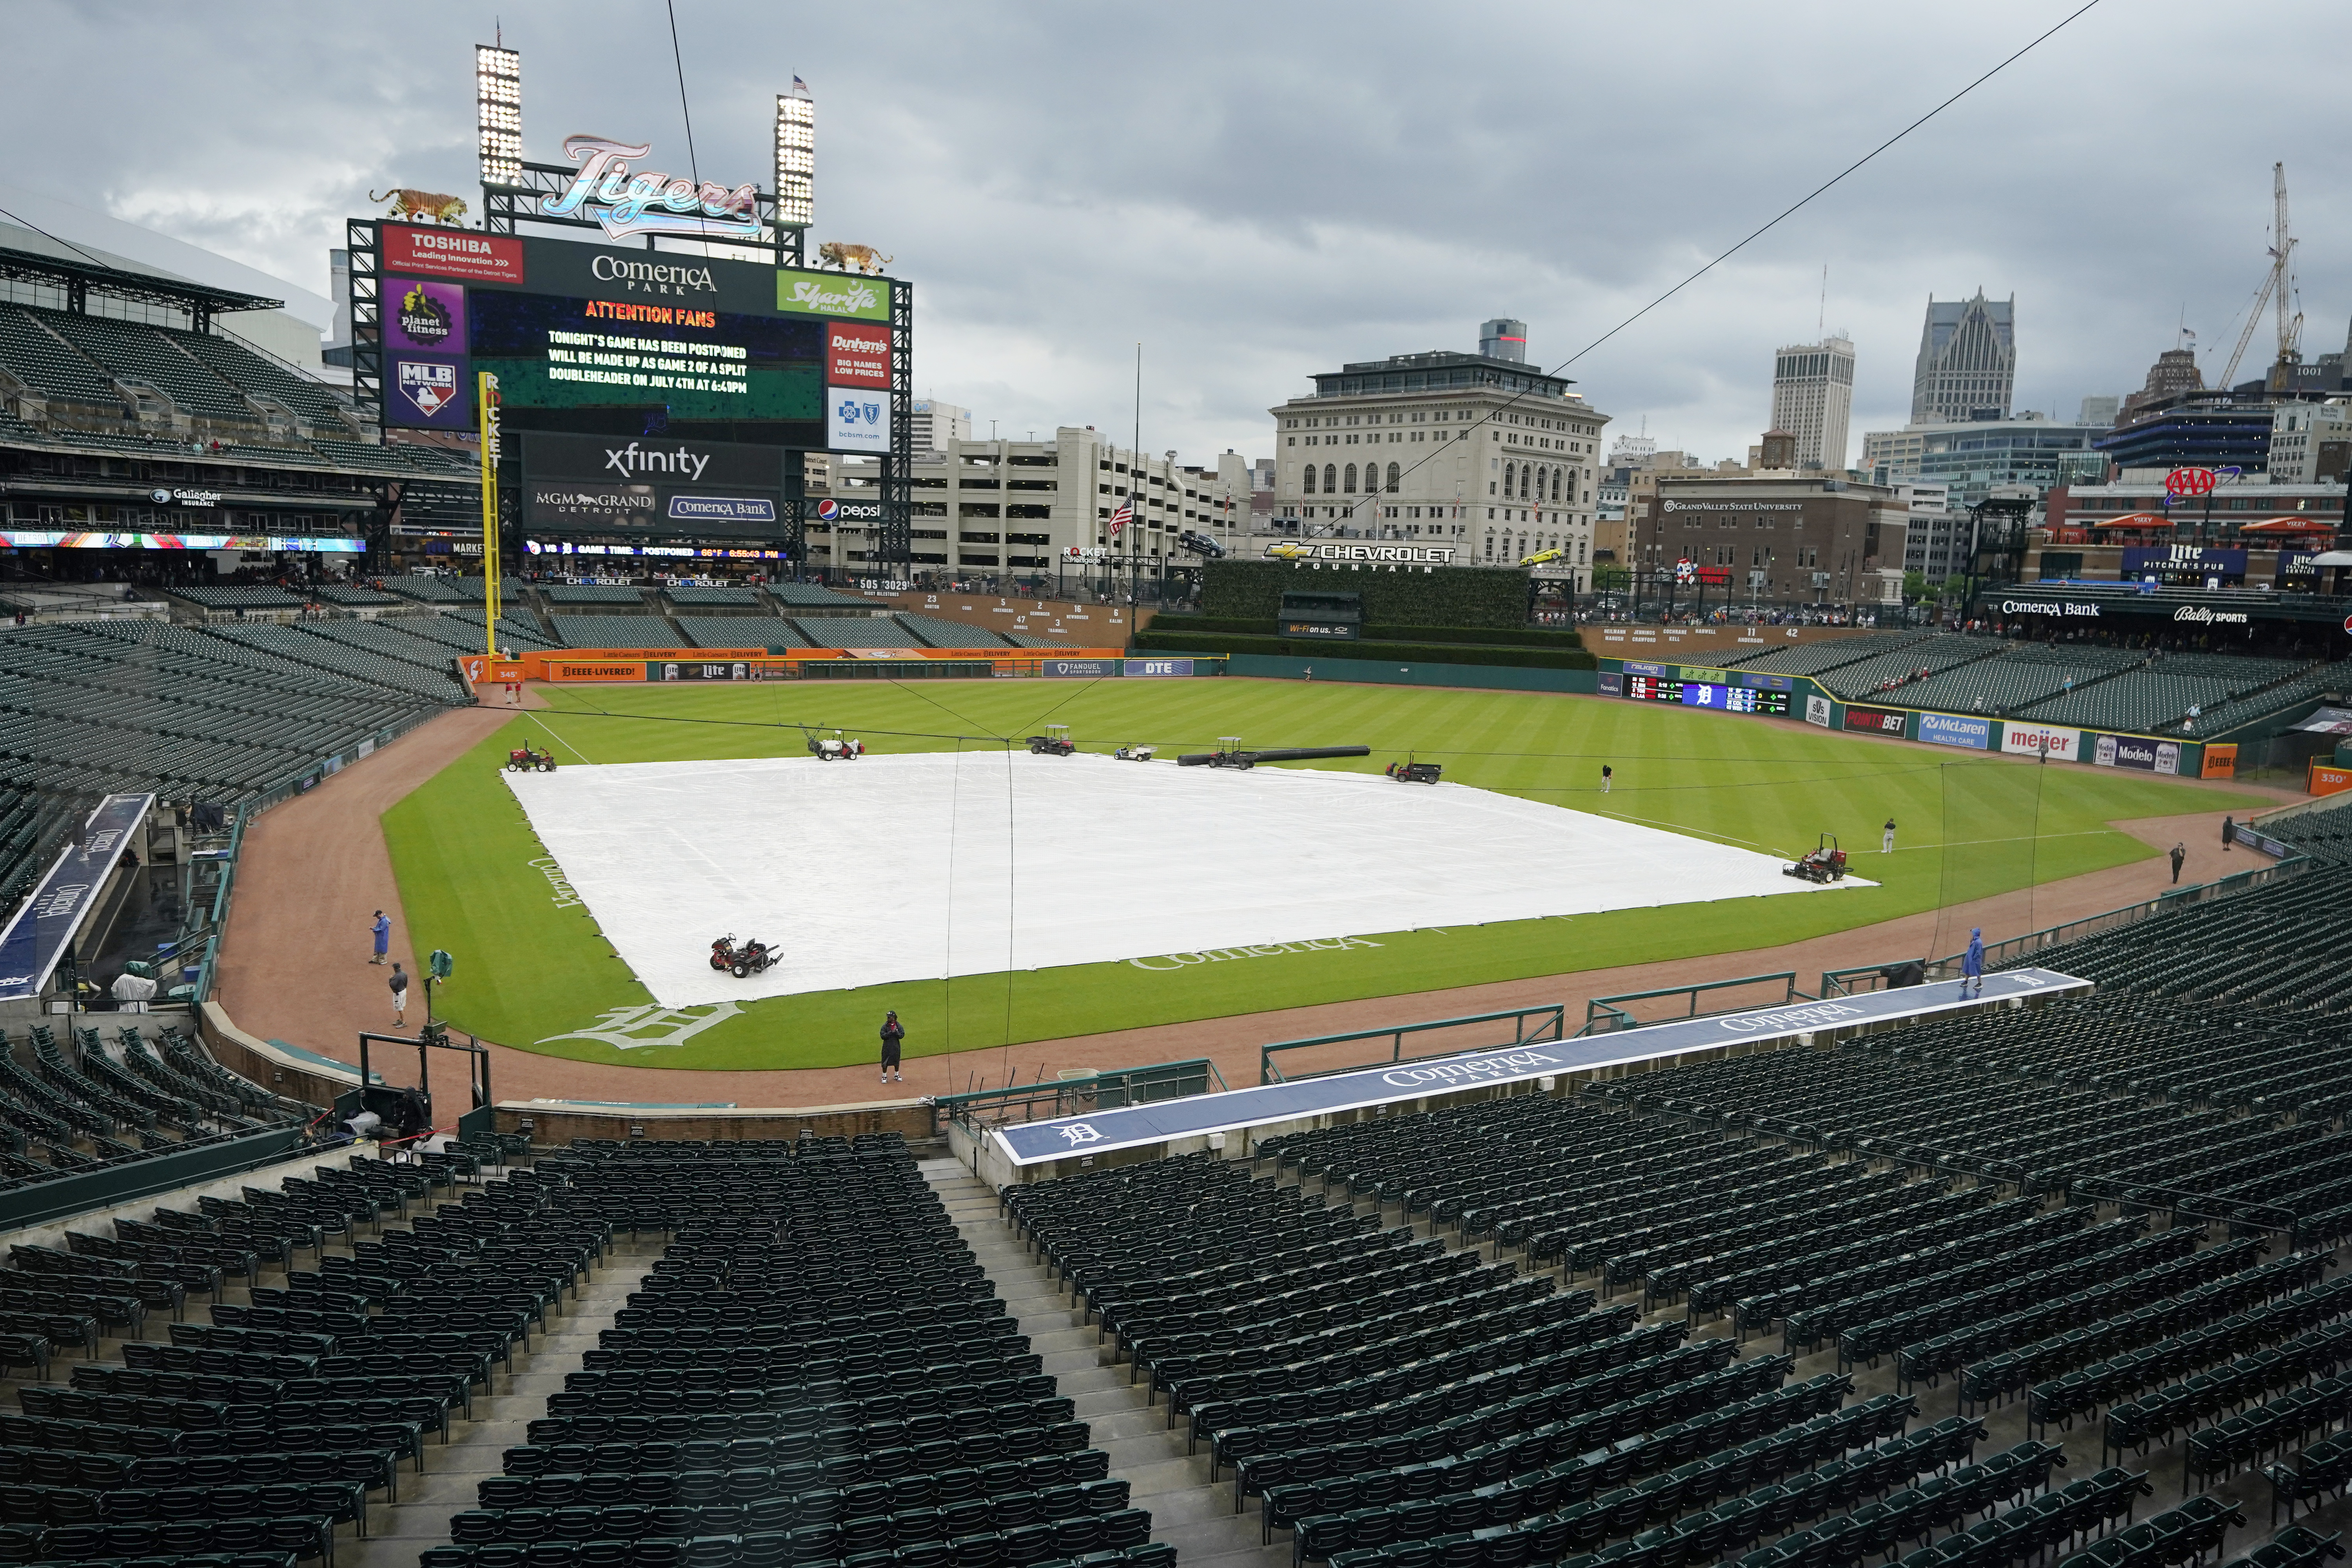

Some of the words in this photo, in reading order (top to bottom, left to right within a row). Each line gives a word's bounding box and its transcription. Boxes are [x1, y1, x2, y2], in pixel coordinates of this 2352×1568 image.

[540, 134, 762, 243] Tigers
[412, 234, 492, 254] TOSHIBA
[412, 250, 446, 261] Leading
[448, 254, 492, 265] Innovation
[627, 281, 685, 296] PARK
[585, 300, 672, 324] ATTENTION
[676, 309, 715, 328] FANS
[820, 305, 848, 313] HALAL
[402, 315, 439, 327] planet
[407, 324, 448, 336] fitness
[548, 330, 605, 347] TONIGHT'S
[607, 336, 636, 350] GAME
[638, 339, 659, 352] HAS
[661, 341, 686, 354] BEEN
[689, 343, 746, 359] POSTPONED
[832, 336, 887, 352] Dunham's
[549, 349, 577, 363] WILL
[579, 352, 592, 364] BE
[594, 353, 624, 367] MADE
[626, 356, 640, 367] UP
[642, 357, 656, 369] AS
[658, 358, 686, 372] GAME
[688, 360, 694, 372] 2
[696, 361, 708, 373] OF
[710, 363, 717, 374] A
[719, 363, 747, 376] SPLIT
[854, 361, 882, 369] NAMES
[402, 365, 452, 381] MLB
[855, 369, 884, 377] PRICES
[2297, 367, 2321, 376] 1001
[403, 379, 452, 388] NETWORK
[549, 367, 631, 385] DOUBLEHEADER
[633, 374, 648, 386] ON
[649, 375, 674, 388] JULY
[675, 377, 695, 390] 4TH
[696, 379, 710, 390] AT
[711, 380, 747, 394] 6:40PM
[839, 431, 879, 439] bcbsm.com
[605, 442, 710, 481] xfinity
[2169, 472, 2212, 492] AAA
[173, 489, 221, 501] Gallagher
[536, 492, 574, 505] MGM
[598, 494, 651, 507] GRAND
[737, 503, 767, 515] Bank
[841, 505, 880, 519] pepsi
[544, 544, 557, 553] VS
[578, 545, 606, 554] GAME
[608, 546, 634, 555] TIME:
[642, 546, 694, 556] POSTPONED
[729, 550, 760, 558] 6:55:43
[1064, 547, 1107, 557] ROCKET
[1320, 544, 1455, 563] CHEVROLET
[2169, 543, 2202, 563] Lite
[1070, 556, 1101, 565] Mortgage
[2144, 561, 2198, 570] PITCHER'S
[2293, 555, 2311, 565] Lite
[1295, 562, 1432, 573] FOUNTAIN
[1698, 567, 1729, 575] BELLE
[566, 577, 632, 586] CHEVROLET
[667, 579, 729, 587] CHEVROLET
[860, 579, 877, 589] 505
[1702, 575, 1724, 584] TIRE
[2064, 603, 2100, 617] Bank
[2174, 605, 2216, 626] Bally
[2216, 613, 2247, 623] SPORTS
[1747, 628, 1755, 637] 11
[1786, 628, 1798, 637] 42
[702, 665, 724, 679] Lite
[1146, 662, 1172, 673] DTE
[1808, 712, 1827, 724] VISION
[1847, 711, 1904, 731] POINTSBET
[1939, 719, 1985, 735] McLaren
[1933, 734, 1956, 743] HEALTH
[2098, 743, 2115, 753] Modelo
[2119, 746, 2152, 762] Modelo
[2158, 750, 2176, 760] Modelo
[1773, 1016, 1838, 1030] PARK
[1444, 1067, 1527, 1085] PARK
